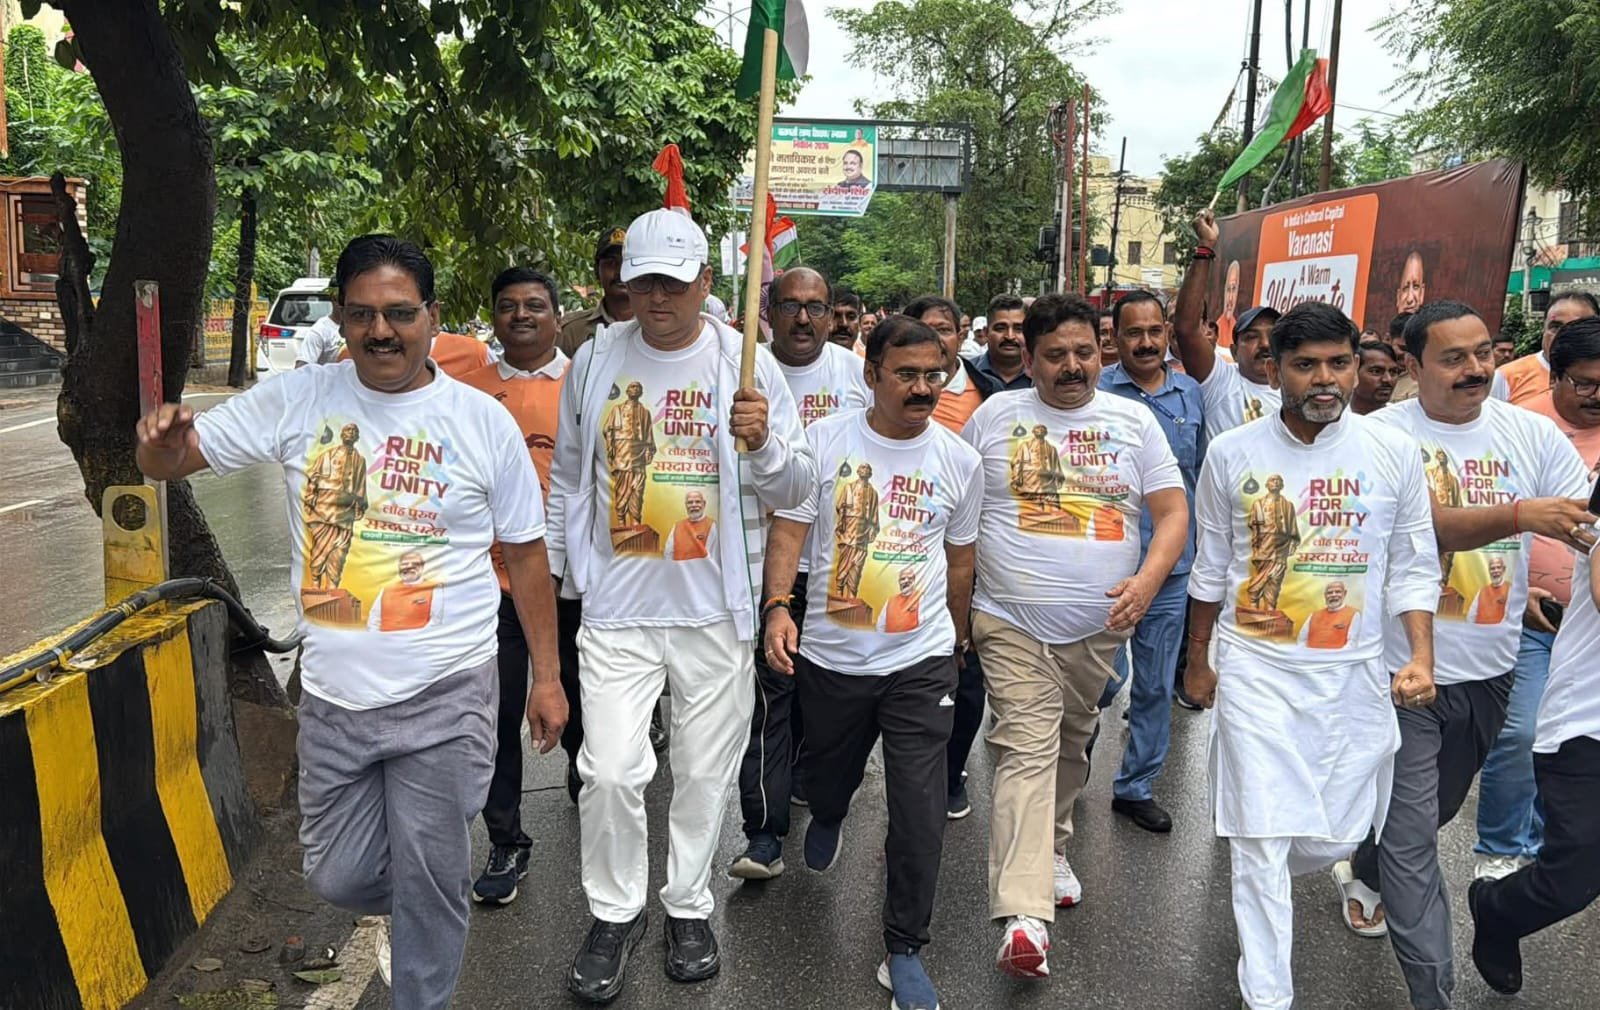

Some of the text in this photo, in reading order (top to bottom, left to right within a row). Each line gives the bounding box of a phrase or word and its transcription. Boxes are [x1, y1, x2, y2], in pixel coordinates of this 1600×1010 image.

[1303, 207, 1324, 224] Cultural
[1324, 205, 1345, 221] Capital
[1287, 224, 1335, 257] Varanasi
[1299, 264, 1331, 286] A Warm
[666, 389, 712, 409] RUN
[803, 394, 839, 409] RUN
[665, 409, 694, 421] FOR
[804, 409, 826, 419] FOR
[664, 421, 719, 438] UNITY
[1069, 430, 1111, 443] RUN
[385, 435, 444, 465] RUN
[668, 447, 687, 456] लौह
[1070, 443, 1096, 454] FOR
[383, 457, 420, 475] FOR
[653, 461, 693, 472] सरदार
[1070, 452, 1119, 467] UNITY
[1464, 459, 1509, 477] RUN
[380, 472, 450, 498] UNITY
[892, 475, 934, 498] RUN
[1310, 479, 1360, 496] RUN
[1467, 477, 1494, 489] FOR
[890, 493, 917, 506] FOR
[1310, 498, 1342, 510] FOR
[1468, 491, 1518, 505] UNITY
[382, 503, 405, 517] लौह
[888, 504, 936, 525] UNITY
[1309, 512, 1367, 528] UNITY
[1313, 538, 1359, 550] लौह पुरुष
[1296, 552, 1369, 564] सरदार पटेल
